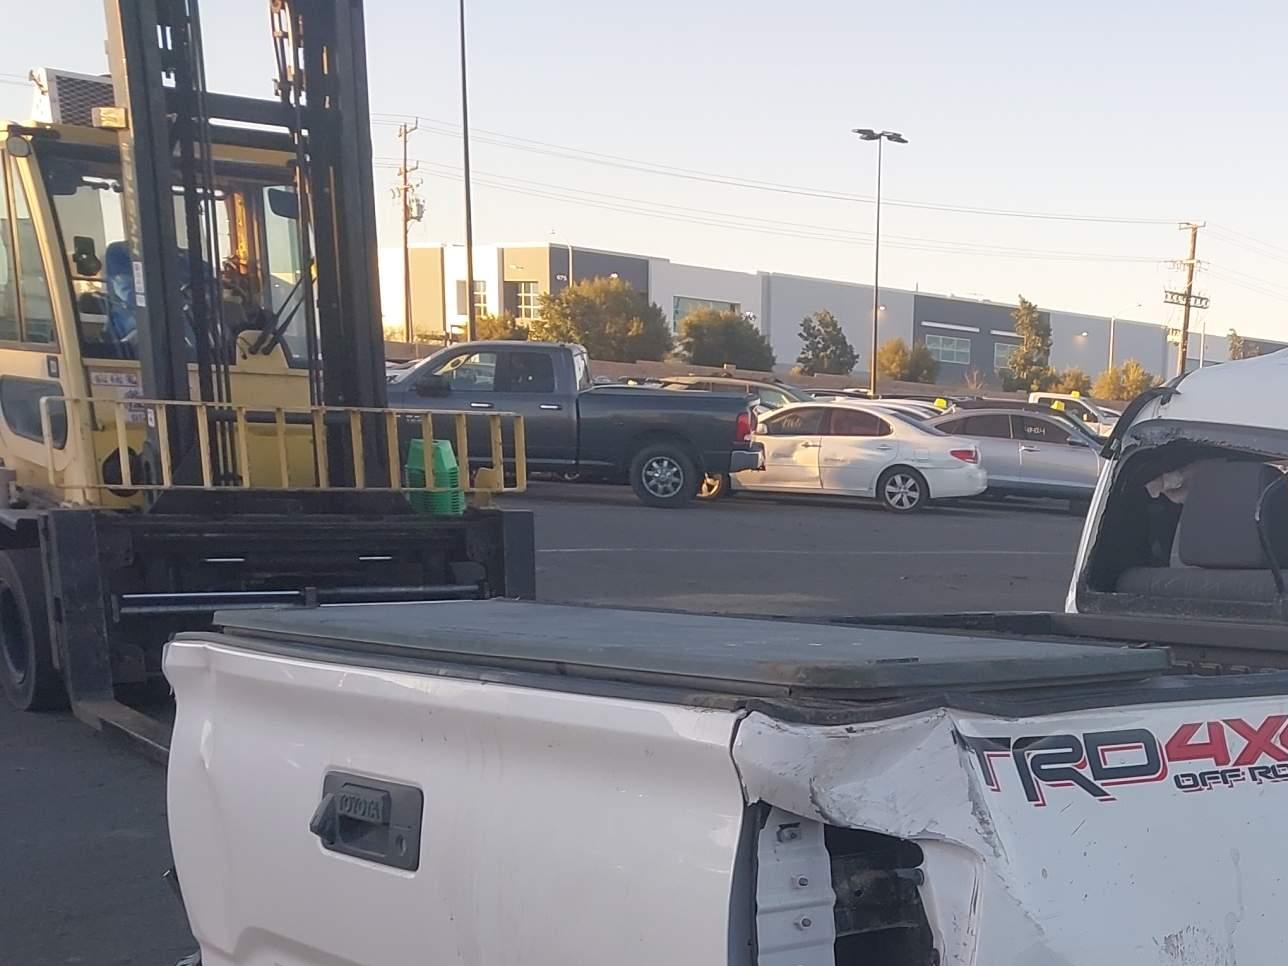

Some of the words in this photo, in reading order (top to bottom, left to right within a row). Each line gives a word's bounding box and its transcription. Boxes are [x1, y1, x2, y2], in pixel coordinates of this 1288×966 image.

[958, 727, 1168, 806] TRD
[1174, 766, 1246, 793] OFF
[340, 794, 381, 820] TOYOTA
